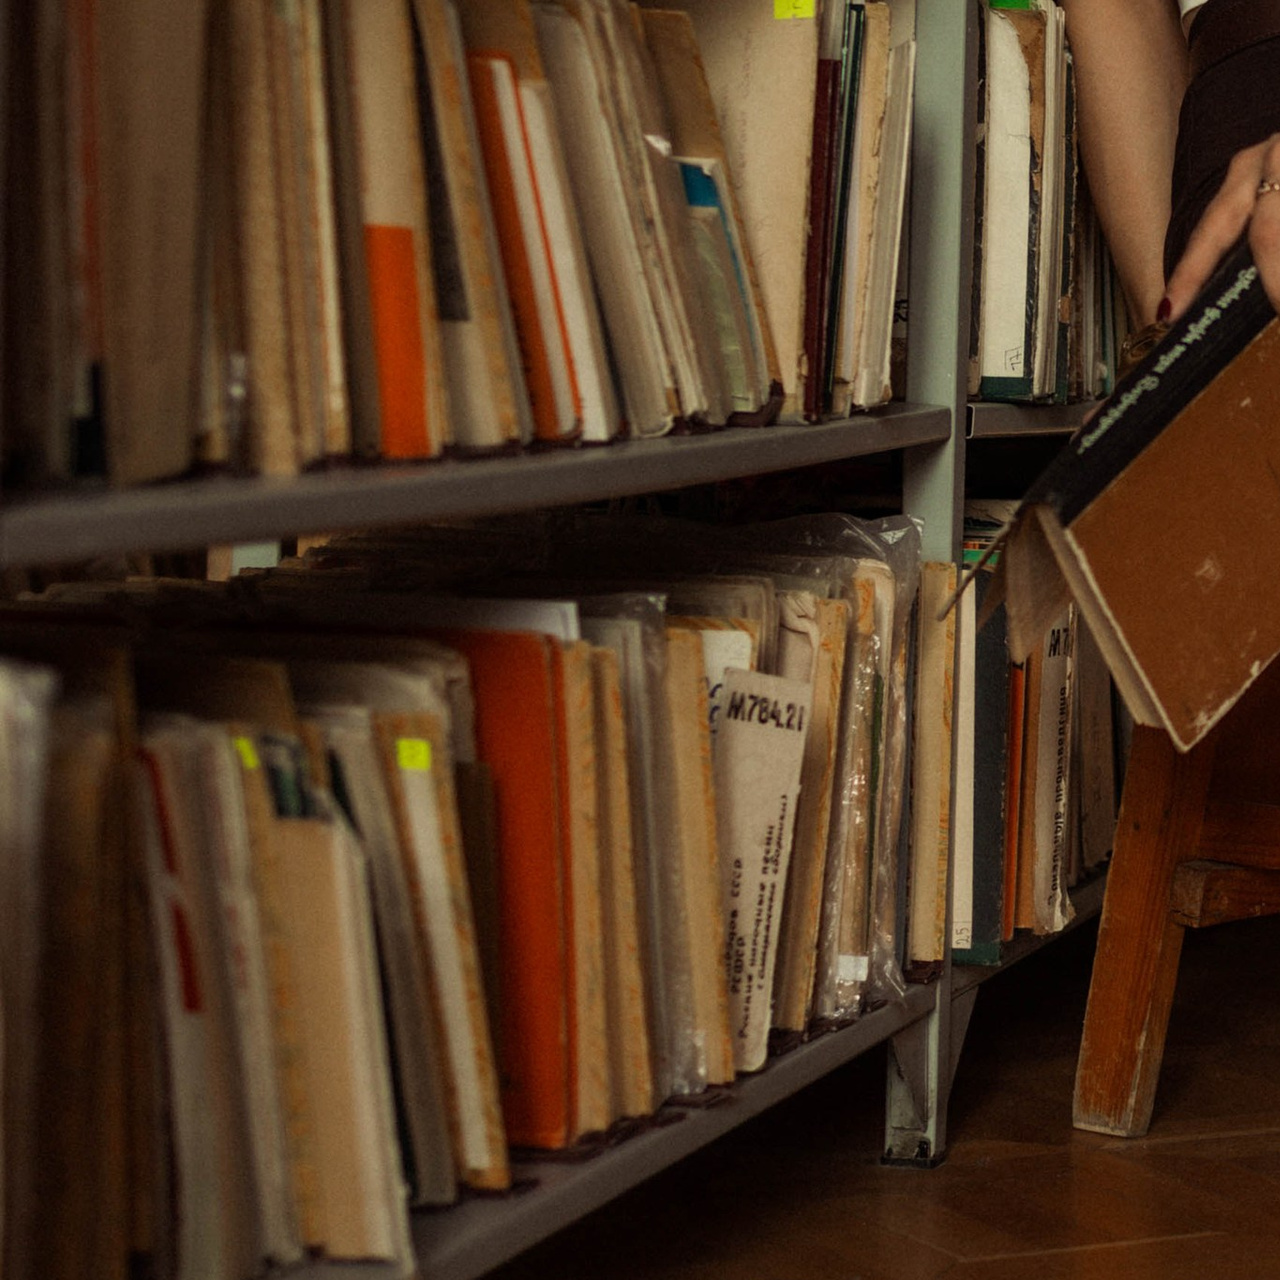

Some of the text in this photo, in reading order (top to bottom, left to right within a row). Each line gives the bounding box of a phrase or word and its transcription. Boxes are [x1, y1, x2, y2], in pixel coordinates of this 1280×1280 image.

[761, 824, 774, 876] песни
[730, 858, 742, 898] СССР
[955, 927, 970, 945] 25
